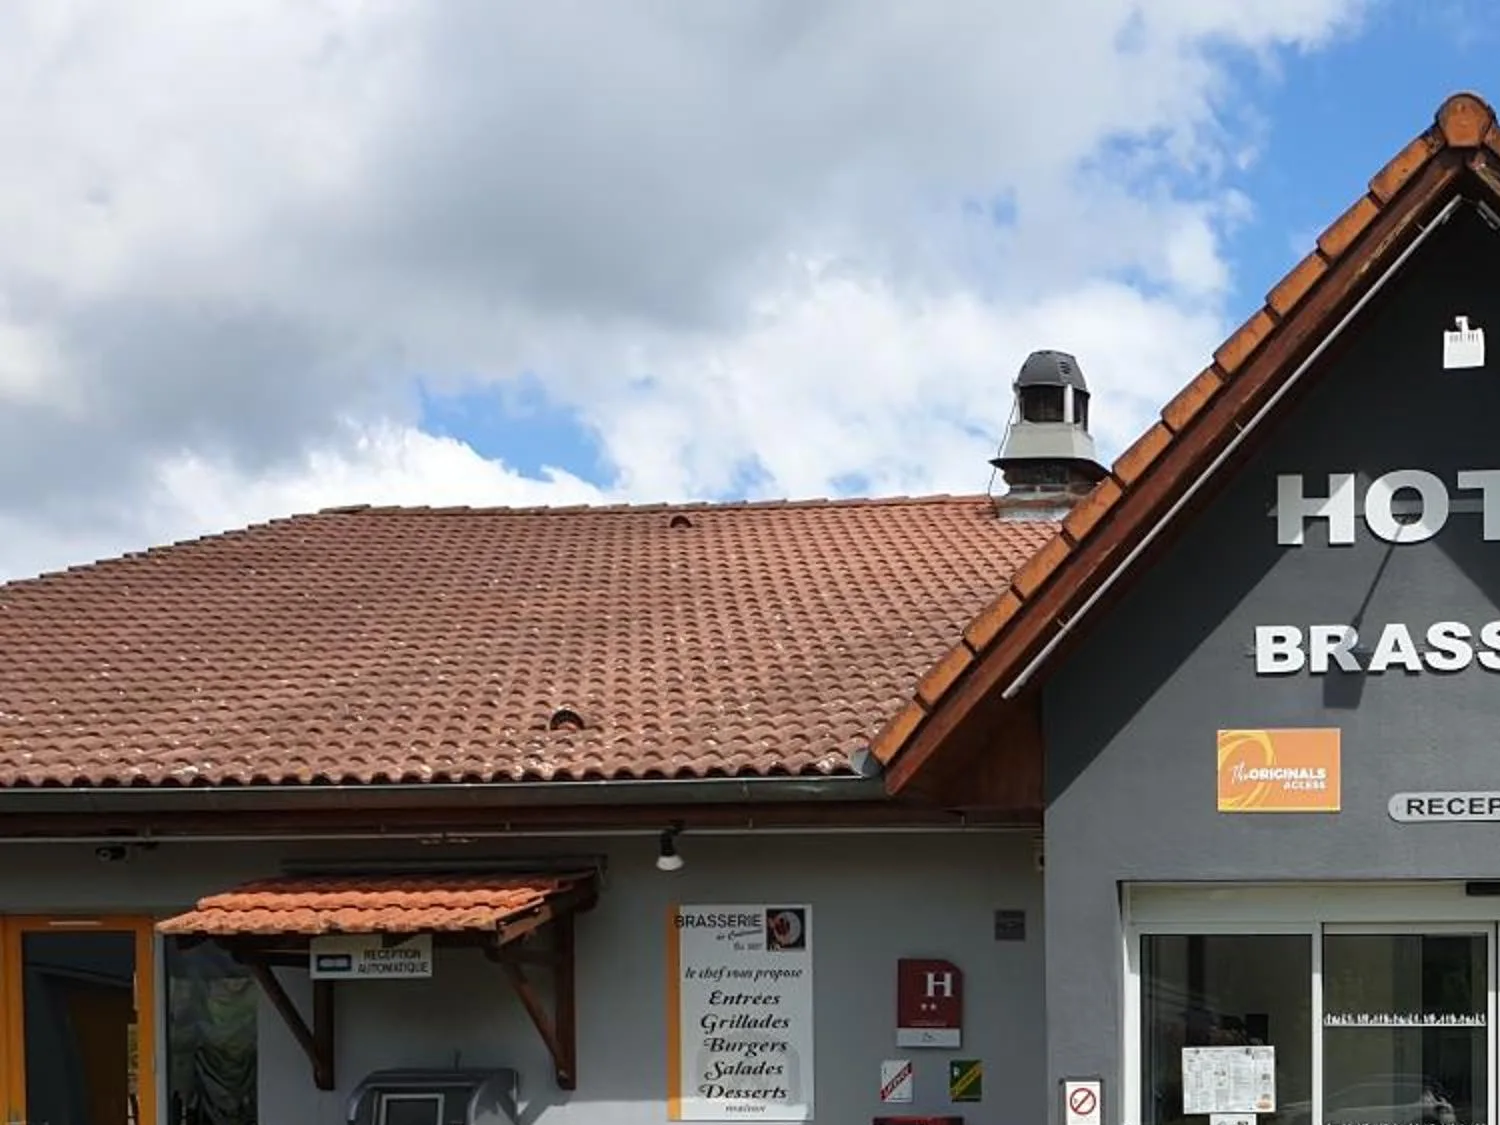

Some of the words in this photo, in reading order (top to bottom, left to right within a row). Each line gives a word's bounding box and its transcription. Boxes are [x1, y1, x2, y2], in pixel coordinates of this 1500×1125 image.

[1249, 767, 1327, 780] ORIGINALS
[674, 913, 762, 928] BRASSERIE
[926, 972, 954, 998] H
[701, 1013, 791, 1034] Grillades
[704, 1037, 788, 1057] Burgers
[704, 1060, 784, 1081] Salades
[698, 1083, 788, 1099] Desserts
